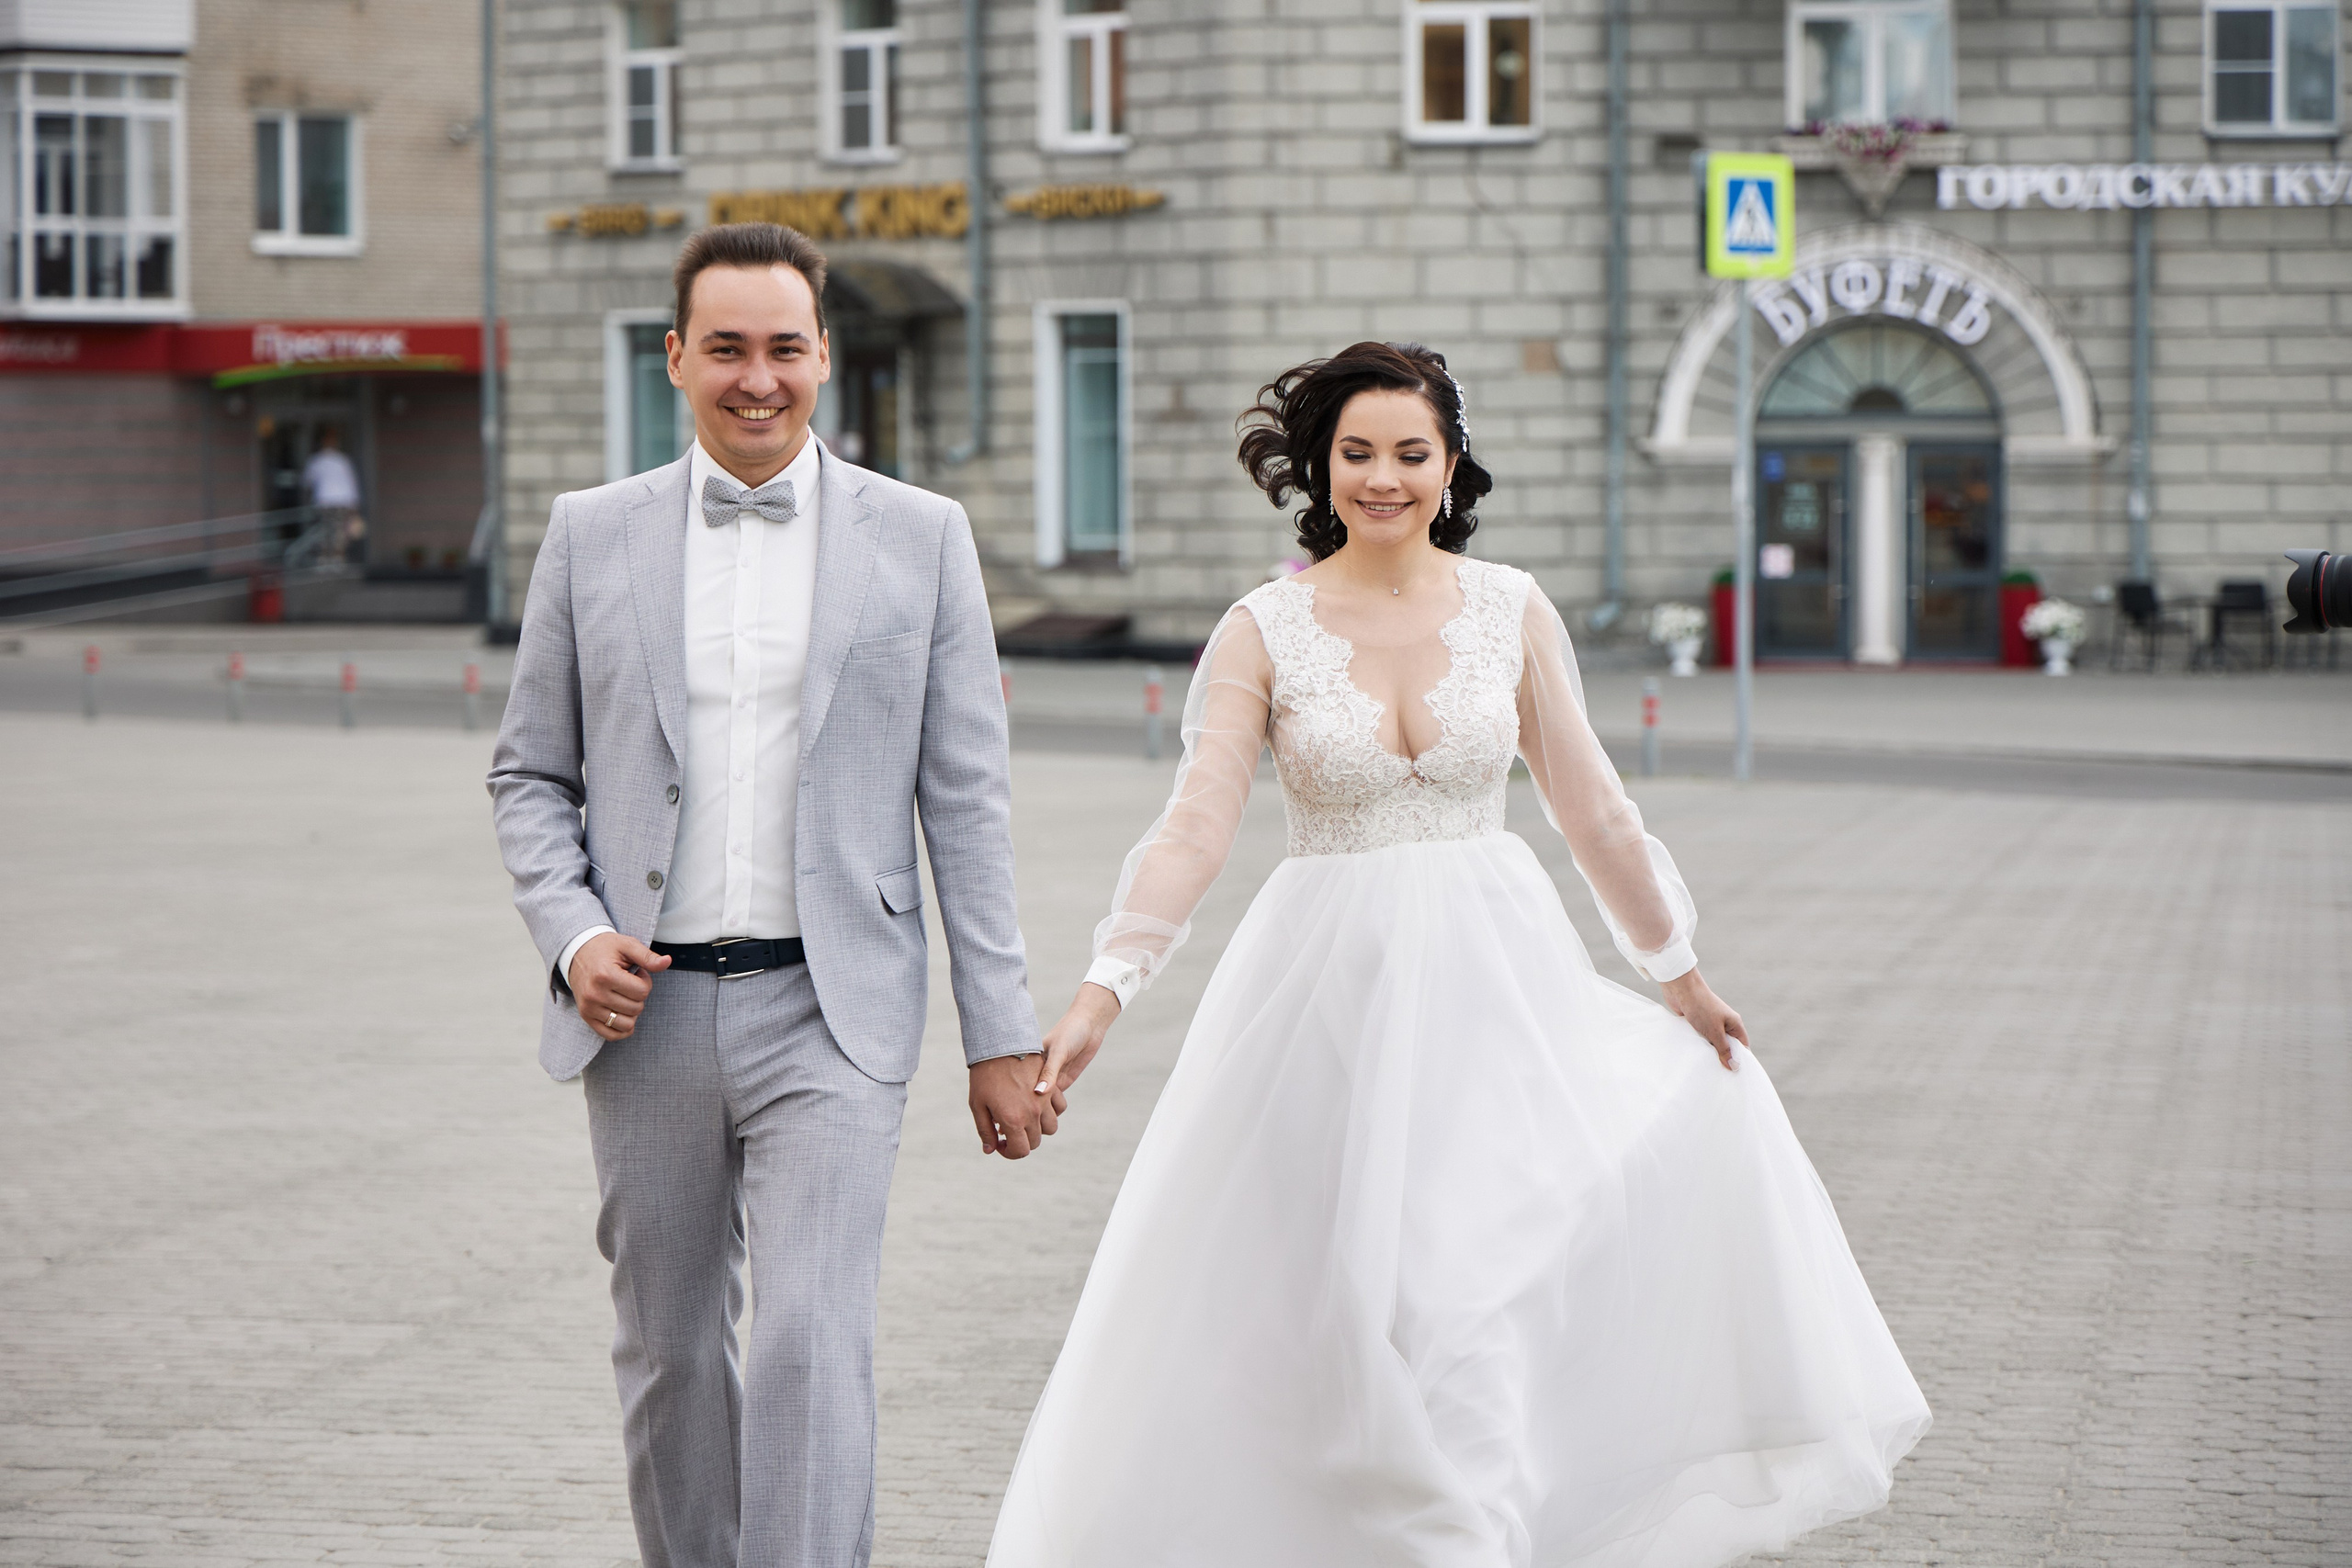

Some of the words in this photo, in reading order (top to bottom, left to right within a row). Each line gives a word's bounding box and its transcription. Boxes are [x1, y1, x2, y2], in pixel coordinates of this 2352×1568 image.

[857, 181, 970, 241] KING
[1937, 164, 2263, 209] ГОРОДСКАЯ
[2274, 164, 2352, 207] КУ
[1753, 260, 1992, 347] БУФЕТЪ
